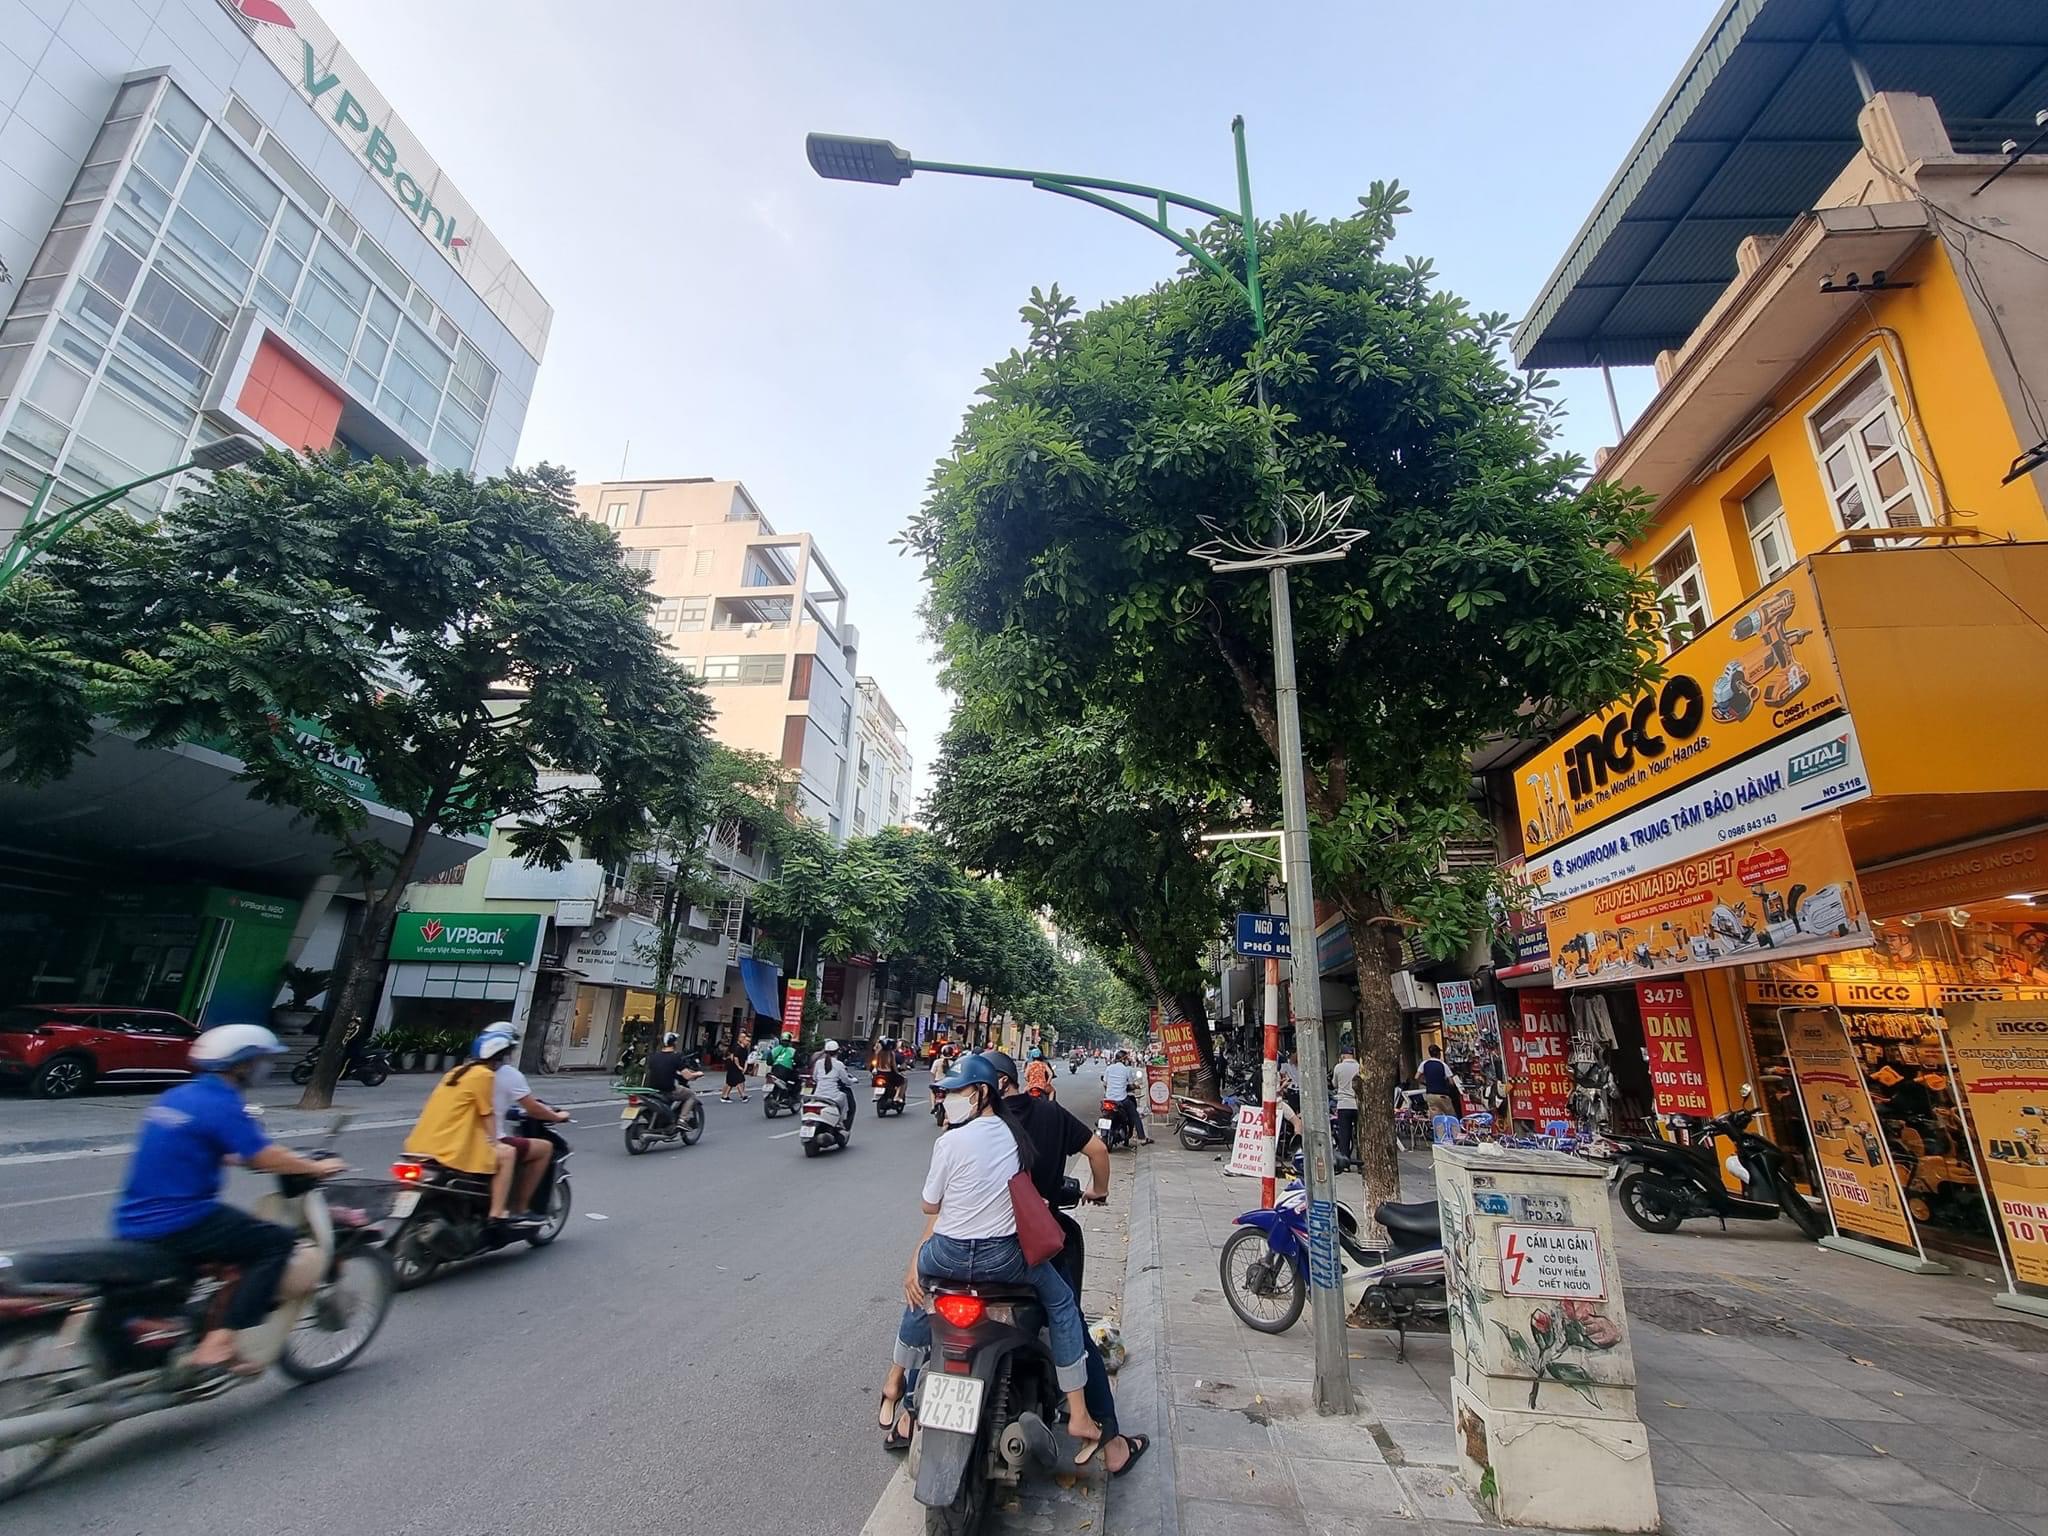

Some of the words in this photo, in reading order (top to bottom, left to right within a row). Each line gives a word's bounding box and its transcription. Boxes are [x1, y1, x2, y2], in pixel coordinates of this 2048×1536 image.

[303, 39, 467, 266] VPBank
[1574, 801, 1593, 816] Make
[1595, 790, 1611, 804] The
[1611, 775, 1636, 796] World
[1637, 769, 1647, 783] In
[1648, 757, 1672, 775] Your
[1673, 736, 1710, 765] Hands
[1822, 786, 1837, 798] NO
[1839, 777, 1862, 793] S118
[1566, 840, 1618, 874] SHOWROOM
[1620, 836, 1630, 852] &
[1630, 818, 1670, 848] TRUNG
[1672, 806, 1703, 831] TÂM
[1704, 790, 1734, 819] BẢO
[1736, 769, 1782, 806] HÀNH
[1728, 823, 1746, 838] 0986
[1747, 818, 1762, 832] 843
[1763, 813, 1777, 827] 143
[1594, 882, 1640, 914] KHUYẾN
[1640, 874, 1664, 900] MÃI
[1665, 865, 1696, 894] ĐẶC
[1698, 852, 1732, 885] BIỆT
[446, 927, 505, 944] VPBank
[1254, 918, 1273, 935] NGÕ
[1279, 921, 1290, 936] 34
[1243, 940, 1272, 952] PHỐ
[1276, 944, 1291, 954] HU
[1524, 1010, 1568, 1034] DÁN
[1647, 1012, 1693, 1038] DÁN
[1659, 1041, 1689, 1063] XE
[1530, 1063, 1551, 1079] BỌC
[1553, 1061, 1569, 1076] YÊ
[1655, 1071, 1678, 1087] BỌC
[1680, 1070, 1703, 1085] YÊN
[1532, 1080, 1546, 1095] ÉP
[1551, 1080, 1570, 1095] BIỂ
[1658, 1092, 1674, 1107] ÉP
[1678, 1090, 1707, 1109] BIỂN
[1238, 1127, 1250, 1139] XE
[1253, 1130, 1263, 1141] M
[1828, 1182, 1841, 1197] 10
[1840, 1184, 1870, 1205] TRIỆU
[2003, 1202, 2034, 1218] ĐƠN
[2036, 1206, 2048, 1219] H
[2008, 1221, 2035, 1241] 10
[1526, 1231, 1548, 1249] CẤM
[1549, 1237, 1566, 1252] LẠI
[1543, 1252, 1556, 1264] CÓ
[1558, 1253, 1579, 1265] ĐIỆN
[1538, 1267, 1563, 1276] NGUY
[1565, 1265, 1587, 1278] HIỂM
[1538, 1276, 1562, 1289] CHẾT
[1563, 1279, 1591, 1291] NGƯỜI
[930, 1376, 975, 1405] 37-B2
[922, 1400, 975, 1432] 747.31
